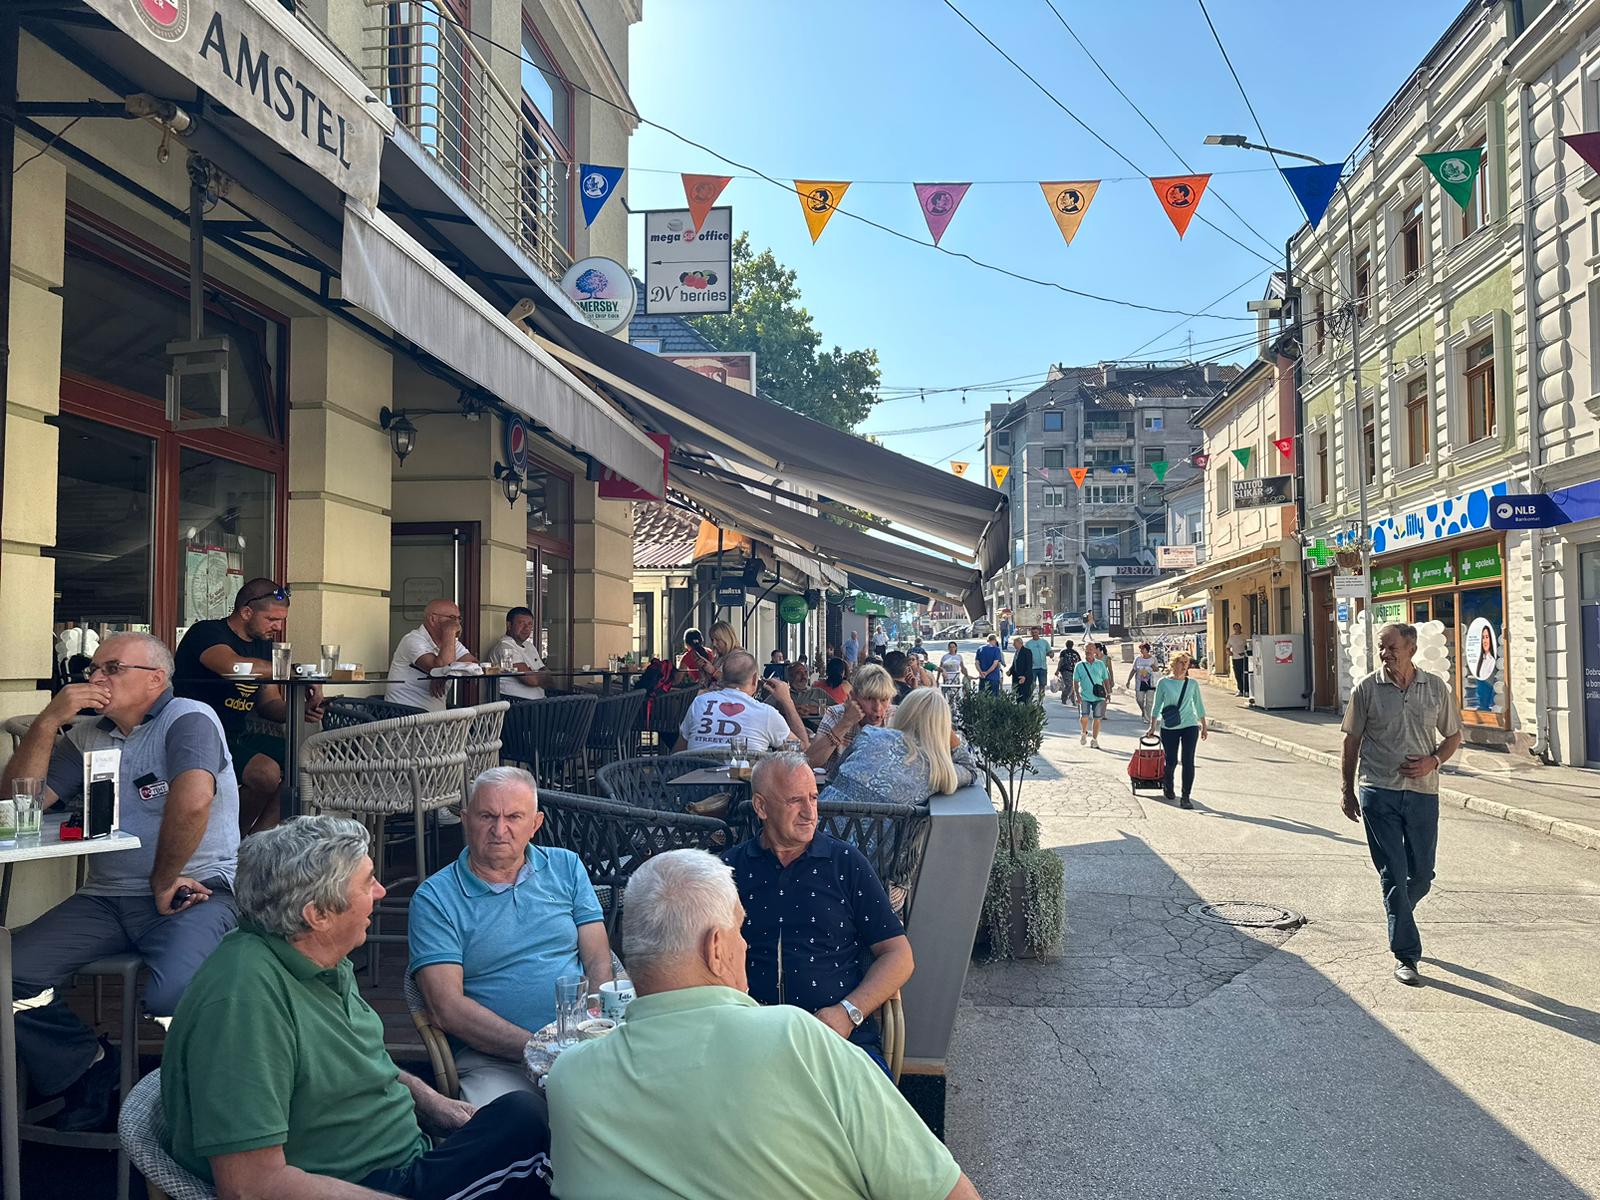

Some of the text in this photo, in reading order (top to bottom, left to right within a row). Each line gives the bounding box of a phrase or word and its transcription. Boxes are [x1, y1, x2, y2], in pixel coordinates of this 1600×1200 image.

[199, 11, 351, 170] AMSTEL
[650, 234, 681, 244] mega
[698, 230, 729, 241] office
[650, 286, 727, 303] DV berries
[576, 301, 619, 312] MERSBY
[1235, 480, 1263, 490] TATTOO
[1234, 488, 1263, 498] SLIKAR
[1514, 505, 1536, 515] NLB
[1406, 512, 1424, 540] lilly
[1475, 558, 1495, 569] apoteka
[1422, 568, 1441, 579] pharmacy
[703, 700, 718, 716] I
[697, 717, 742, 736] 3D
